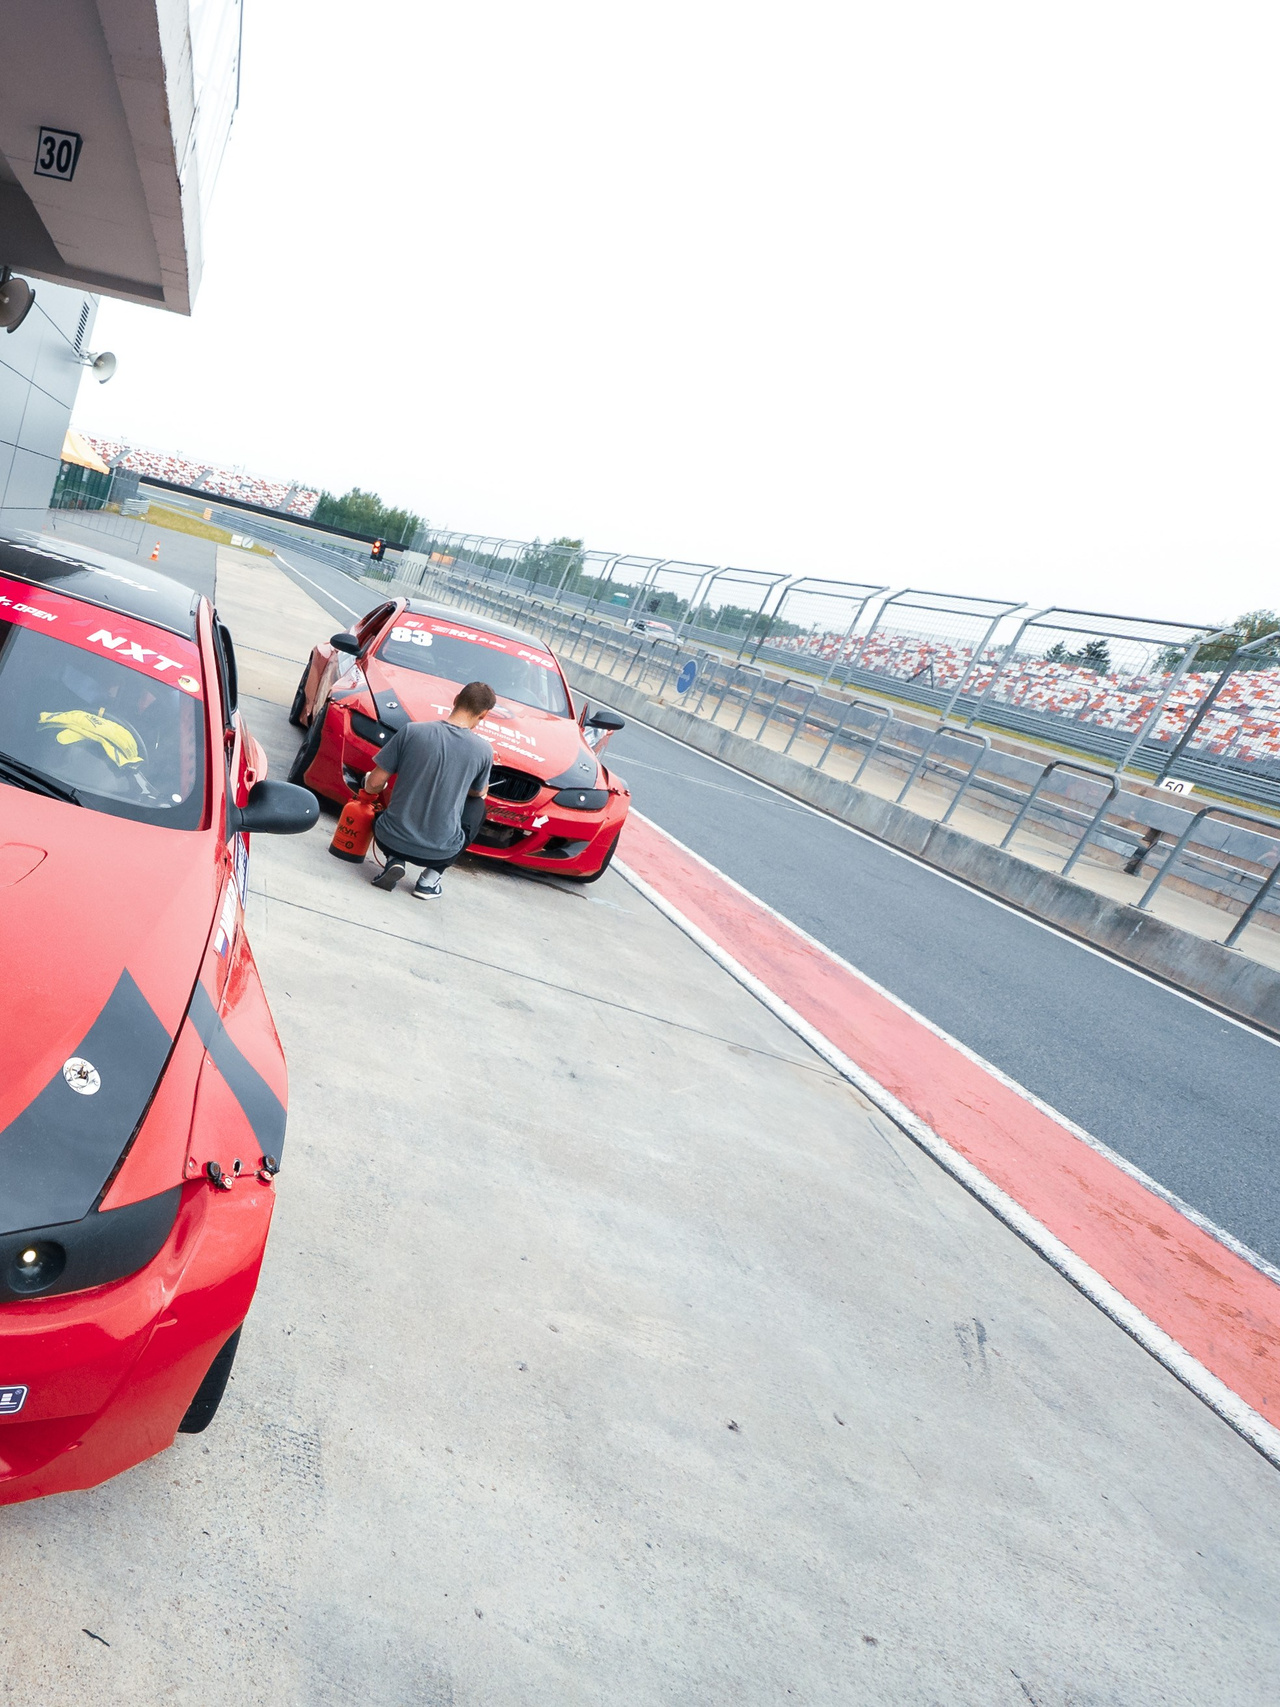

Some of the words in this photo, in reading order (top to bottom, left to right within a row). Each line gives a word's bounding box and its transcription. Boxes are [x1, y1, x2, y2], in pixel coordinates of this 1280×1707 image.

[40, 136, 73, 173] 30
[12, 603, 58, 622] OPEN
[86, 629, 184, 671] NXT
[390, 626, 433, 647] 83
